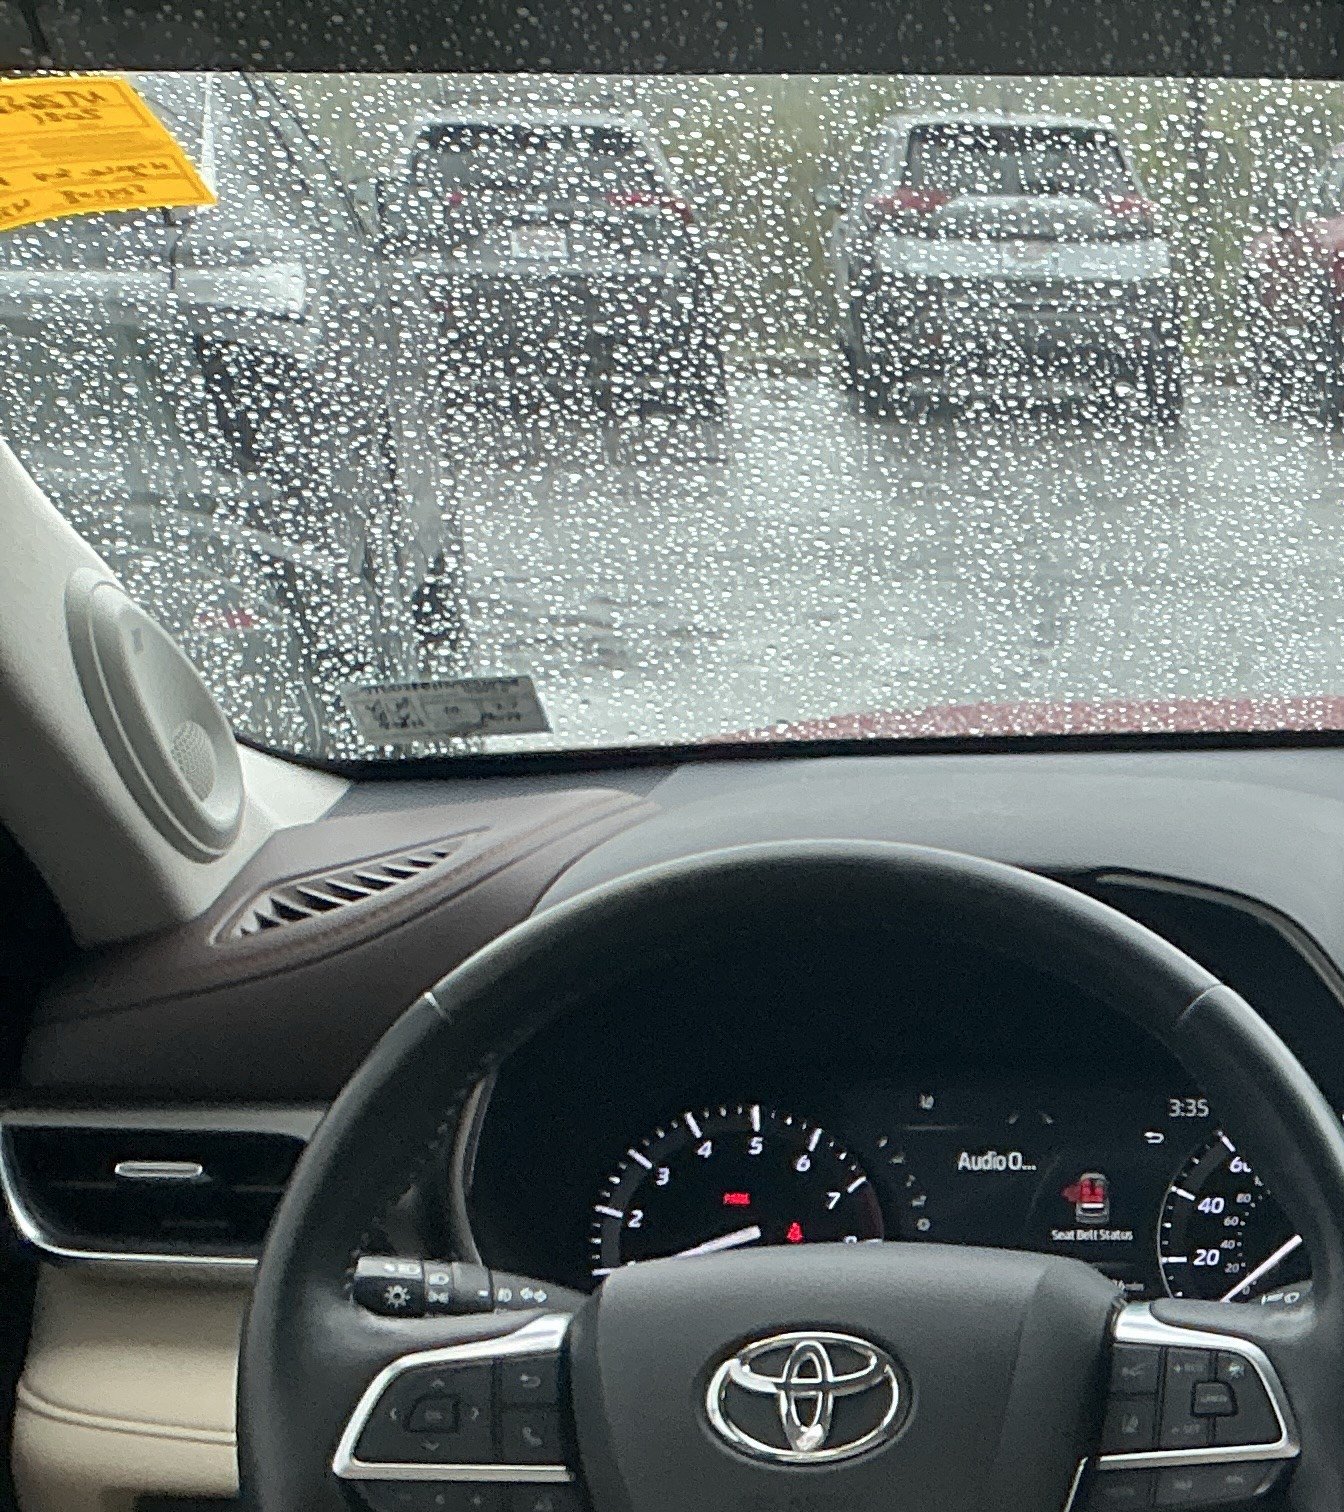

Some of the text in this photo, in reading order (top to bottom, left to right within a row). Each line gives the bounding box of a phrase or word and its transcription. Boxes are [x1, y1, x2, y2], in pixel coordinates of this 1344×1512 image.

[1168, 1098, 1210, 1118] 3:35
[696, 1139, 713, 1159] 4
[747, 1137, 763, 1156] 5
[795, 1154, 811, 1172] 6
[957, 1150, 1007, 1171] Audio
[655, 1166, 670, 1186] 3
[825, 1192, 841, 1210] 7
[1197, 1197, 1225, 1214] 40
[627, 1209, 643, 1228] 2
[1223, 1216, 1239, 1227] 60
[1052, 1229, 1133, 1241] Seat Belt Status
[1220, 1240, 1236, 1250] 40
[1192, 1248, 1221, 1266] 20
[1223, 1262, 1240, 1274] 20
